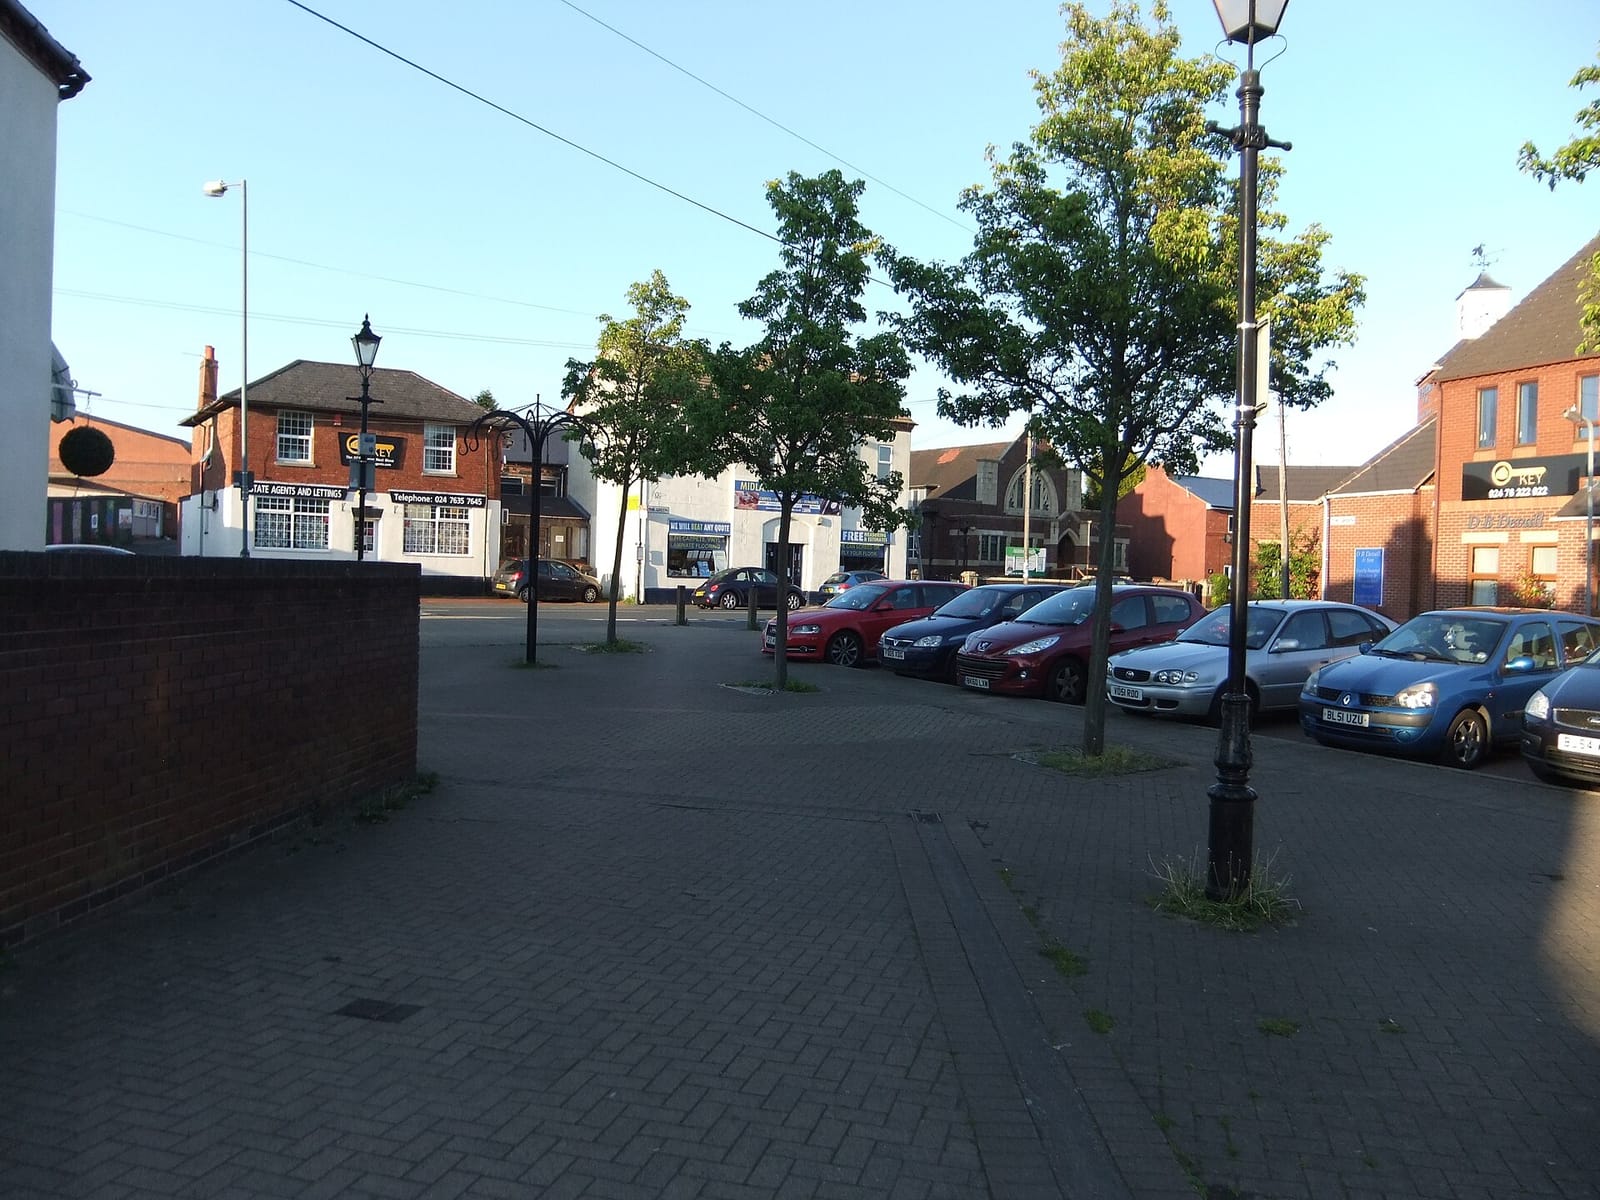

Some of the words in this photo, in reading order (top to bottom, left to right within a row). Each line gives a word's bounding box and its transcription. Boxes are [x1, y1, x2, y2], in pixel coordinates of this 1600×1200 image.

[1520, 473, 1543, 485] KEY
[271, 485, 296, 496] AGENTS
[297, 487, 311, 497] AND
[313, 488, 342, 499] LETTINGS
[1515, 486, 1532, 497] 222
[393, 493, 433, 503] Telephone:
[434, 495, 447, 504] 024
[449, 496, 464, 505] 7635
[466, 497, 482, 506] 7645
[678, 522, 690, 531] WILL
[703, 523, 714, 532] ANY
[714, 524, 730, 533] QUOTE
[842, 531, 864, 542] FREE
[1326, 710, 1345, 722] BL51
[1346, 713, 1363, 725] UZU
